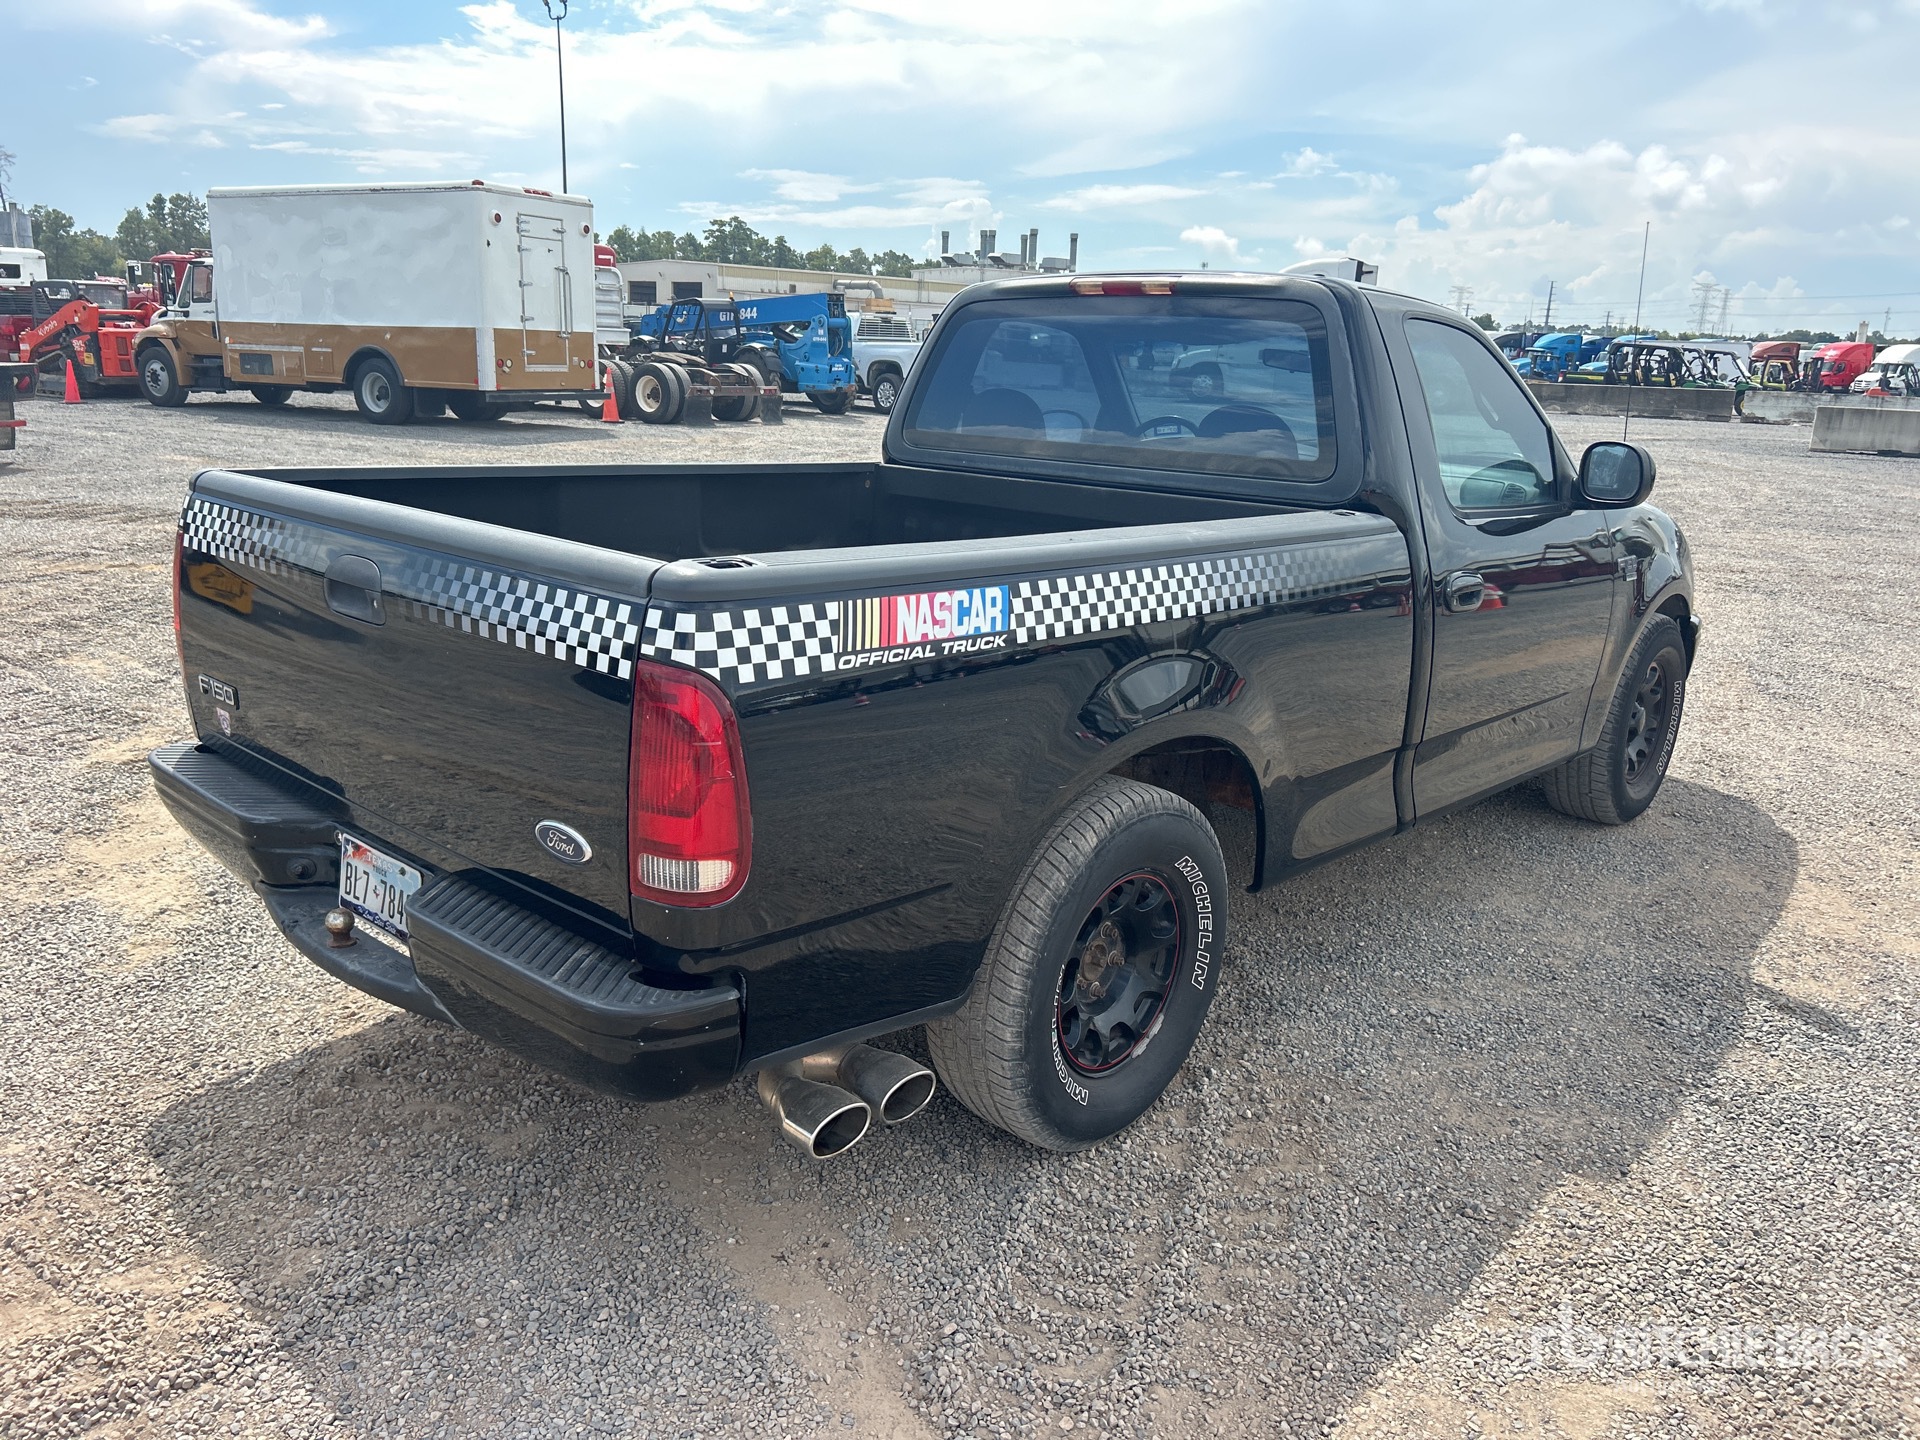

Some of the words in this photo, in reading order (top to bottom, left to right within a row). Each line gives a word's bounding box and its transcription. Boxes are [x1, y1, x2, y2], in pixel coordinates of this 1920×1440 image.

[896, 585, 1003, 644] NASCAR
[838, 644, 936, 670] OFFICIAL
[941, 634, 1008, 655] TRUCK
[1656, 681, 1682, 776] MICHELIN
[367, 852, 393, 872] TEXAS
[548, 829, 575, 856] Ford
[380, 879, 409, 924] 784
[1175, 856, 1213, 990] MICHELIN
